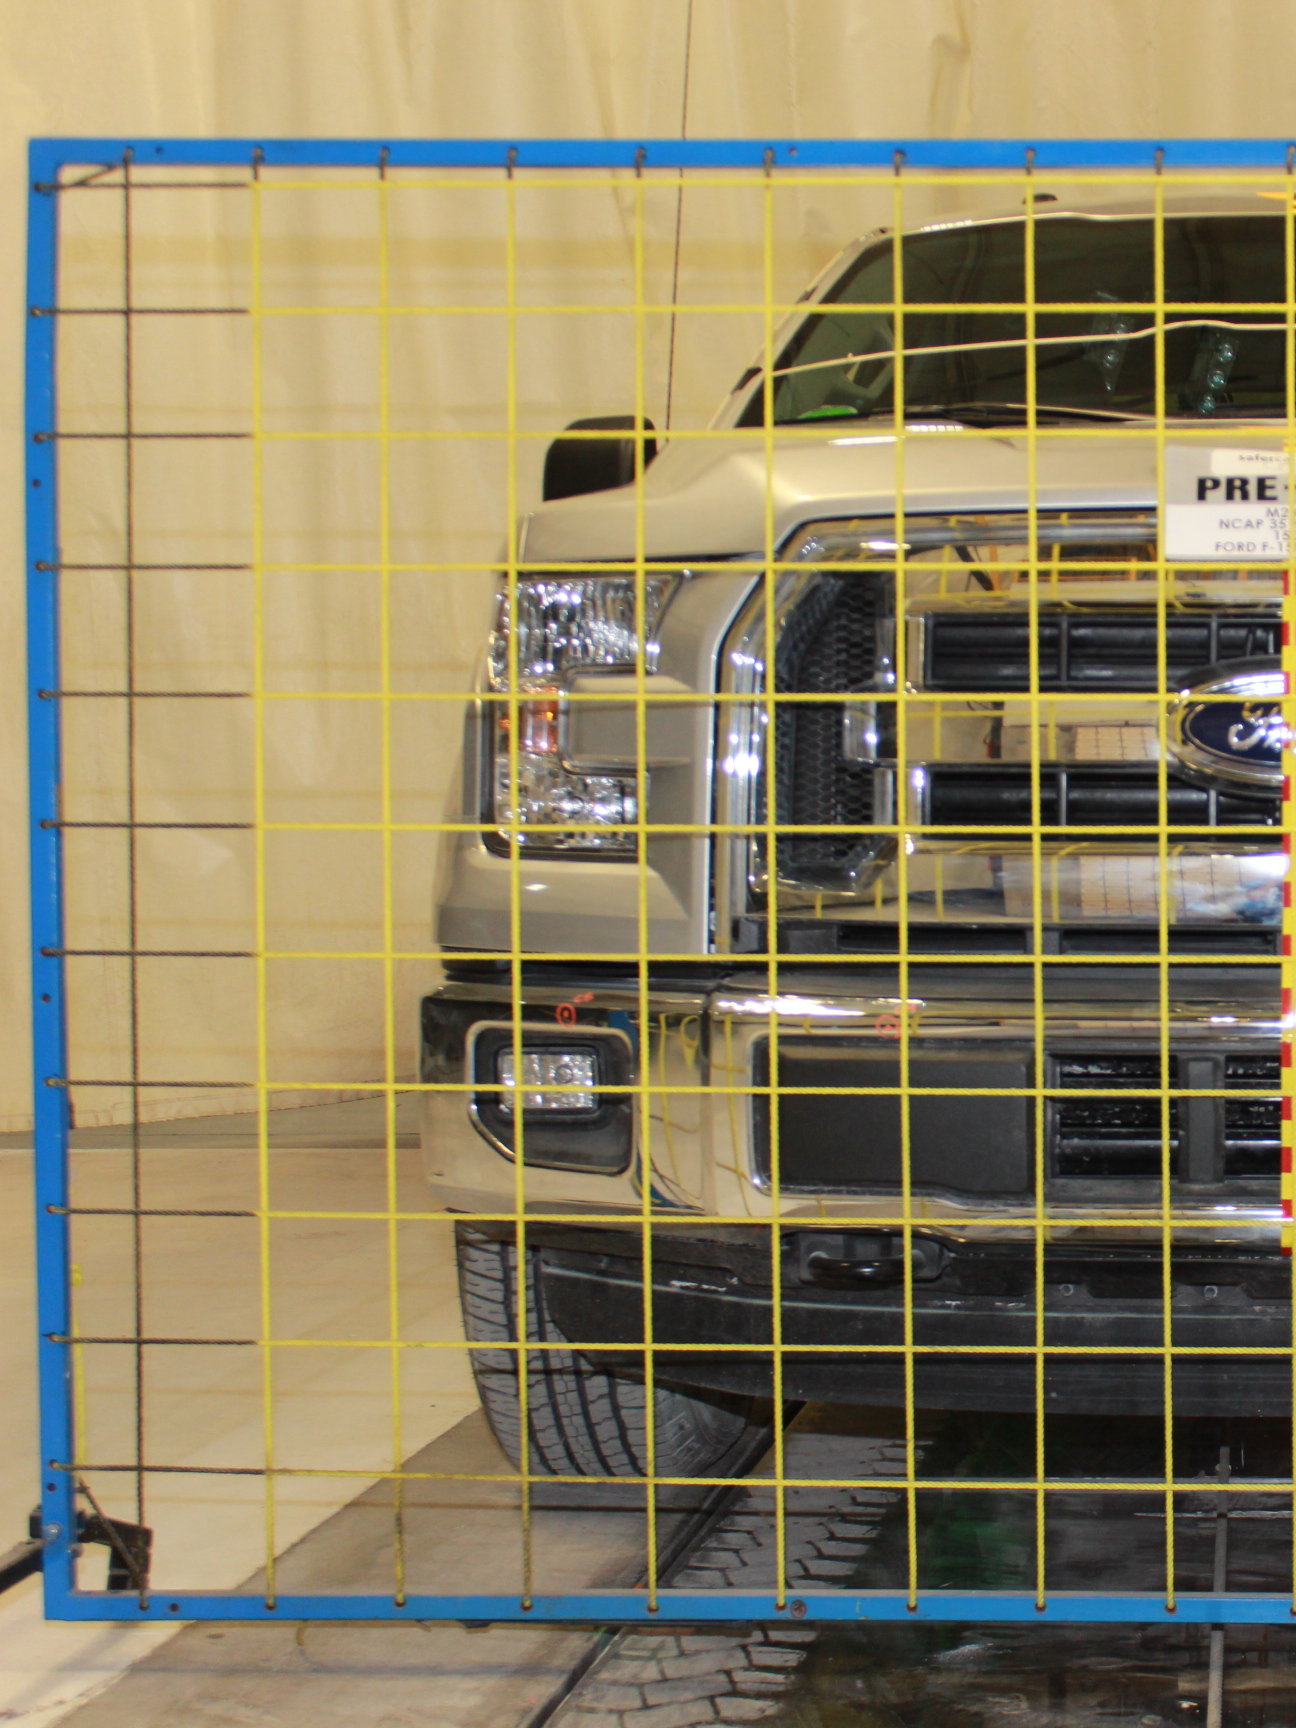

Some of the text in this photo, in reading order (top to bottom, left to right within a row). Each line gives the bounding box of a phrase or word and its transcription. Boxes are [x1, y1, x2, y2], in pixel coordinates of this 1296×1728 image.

[1219, 518, 1264, 529] NCAP
[1269, 518, 1287, 529] 35
[1215, 541, 1257, 552] FORD
